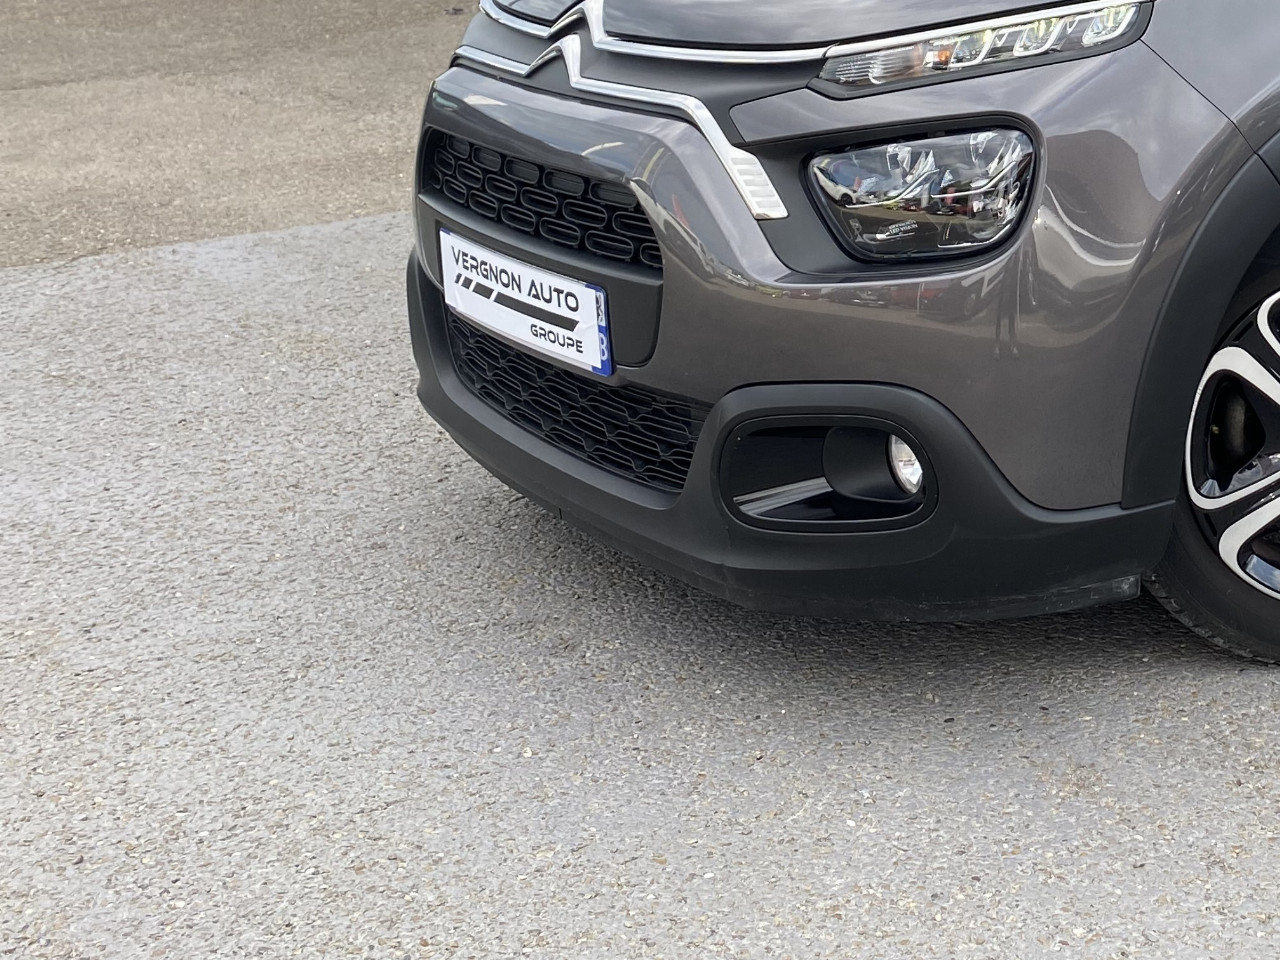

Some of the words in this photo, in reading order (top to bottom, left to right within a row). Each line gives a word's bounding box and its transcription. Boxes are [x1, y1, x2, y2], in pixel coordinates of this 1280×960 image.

[451, 245, 522, 293] VERGNON
[527, 279, 580, 313] AUTO
[530, 323, 584, 354] GROUPE
